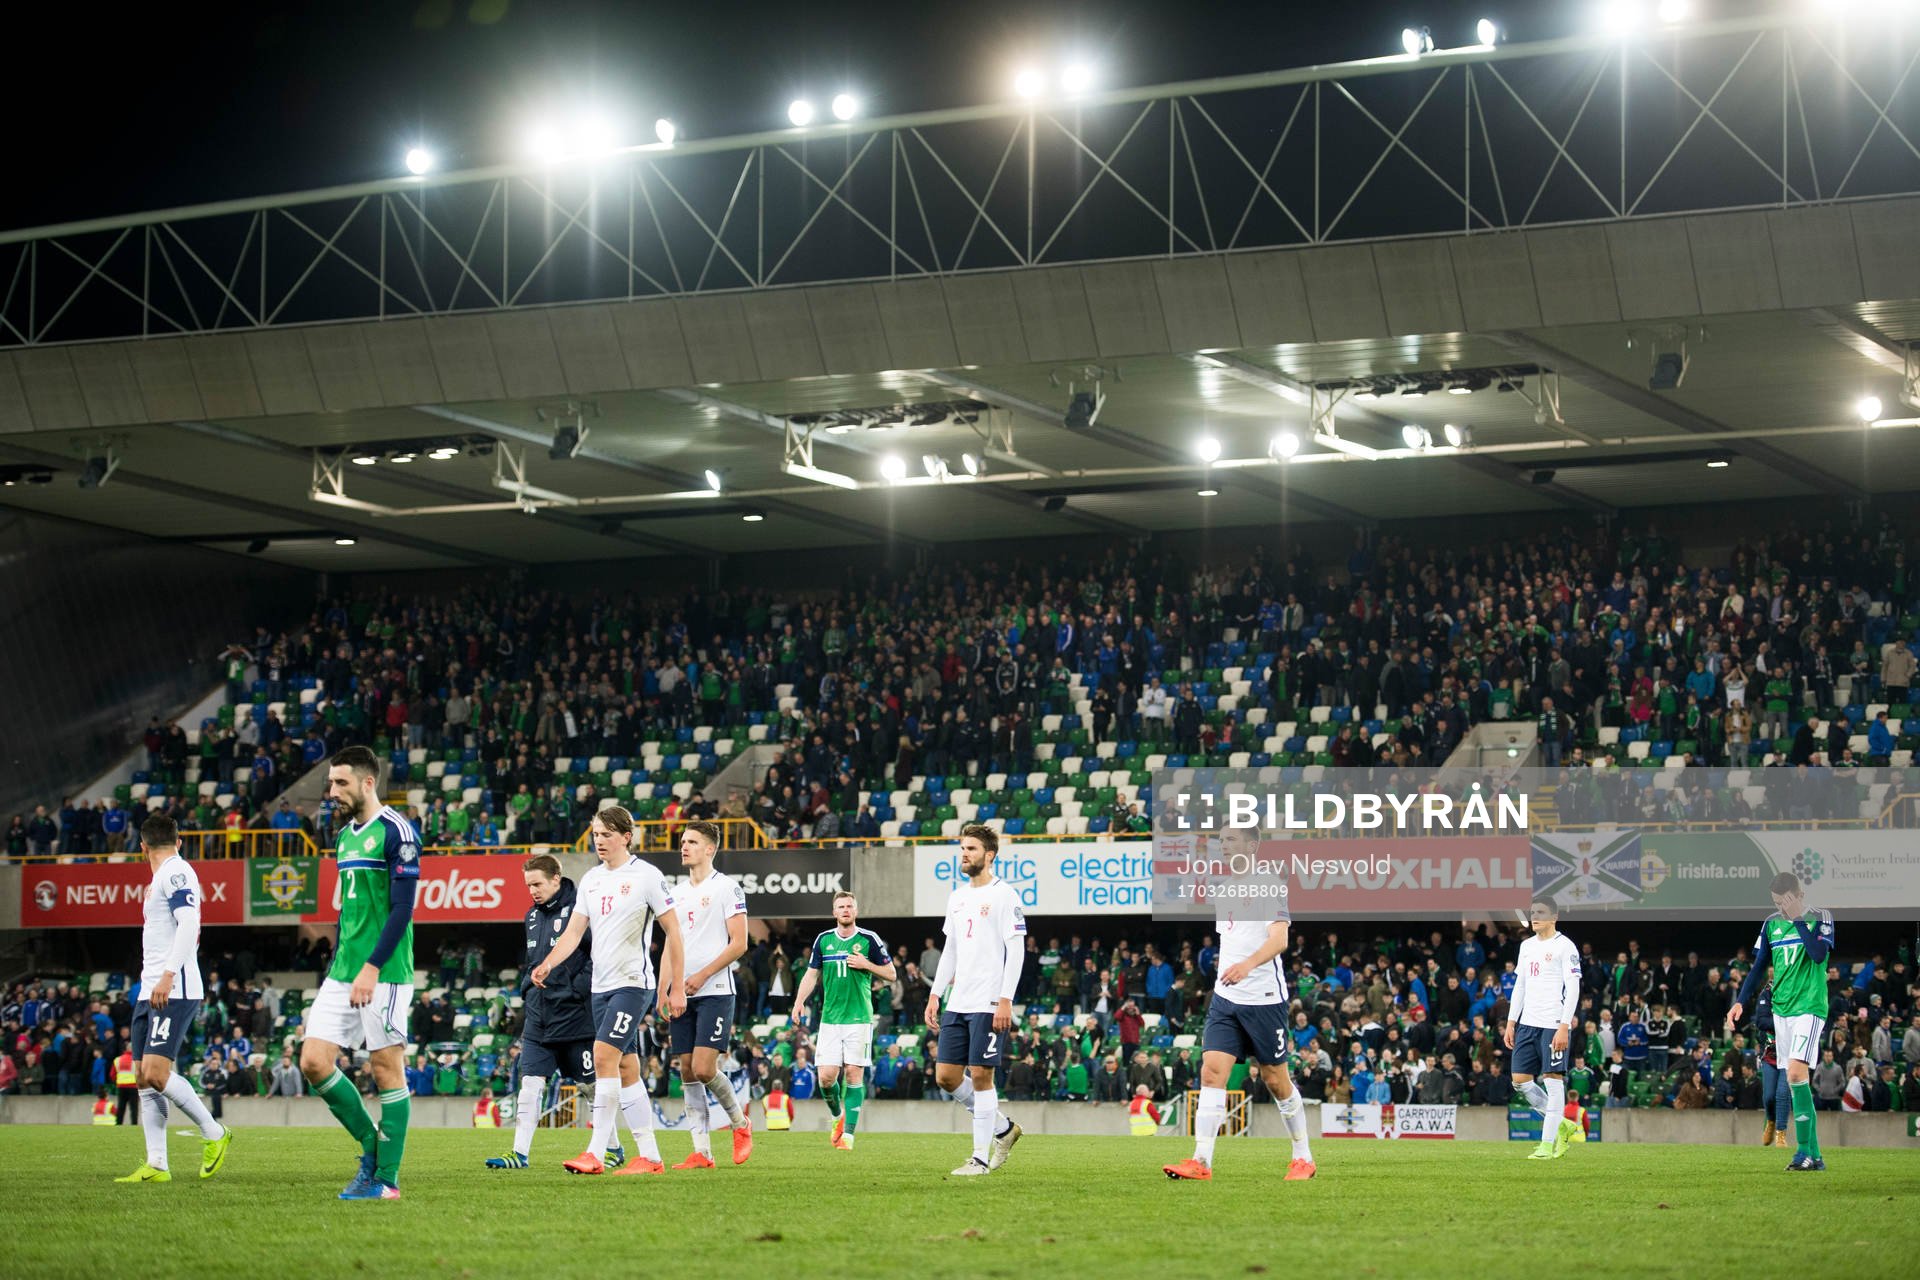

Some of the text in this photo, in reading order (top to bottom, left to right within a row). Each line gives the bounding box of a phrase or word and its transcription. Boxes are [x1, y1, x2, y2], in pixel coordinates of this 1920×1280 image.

[934, 854, 1036, 882] eltric
[1060, 852, 1153, 879] electri
[1605, 859, 1640, 871] WARREN
[1831, 853, 1885, 864] Northern
[1296, 857, 1533, 890] VAUXHALL
[1677, 862, 1761, 879] irishfa.com
[1831, 868, 1888, 879] Executive
[66, 884, 119, 904] NEW
[211, 882, 227, 902] X
[346, 870, 357, 899] 2
[1078, 879, 1153, 906] Irelan
[601, 896, 615, 916] 13
[687, 911, 695, 930] 5
[966, 918, 973, 938] 2
[1783, 945, 1799, 966] 17
[836, 959, 847, 978] 11
[1530, 961, 1541, 977] 18
[150, 1016, 172, 1041] 14
[612, 1011, 633, 1034] 13
[714, 1016, 724, 1036] 5
[986, 1032, 998, 1053] 2
[1275, 1028, 1285, 1051] 3
[1792, 1034, 1809, 1053] 17
[581, 1050, 593, 1070] 8
[1398, 1108, 1455, 1119] CARRYDUFF
